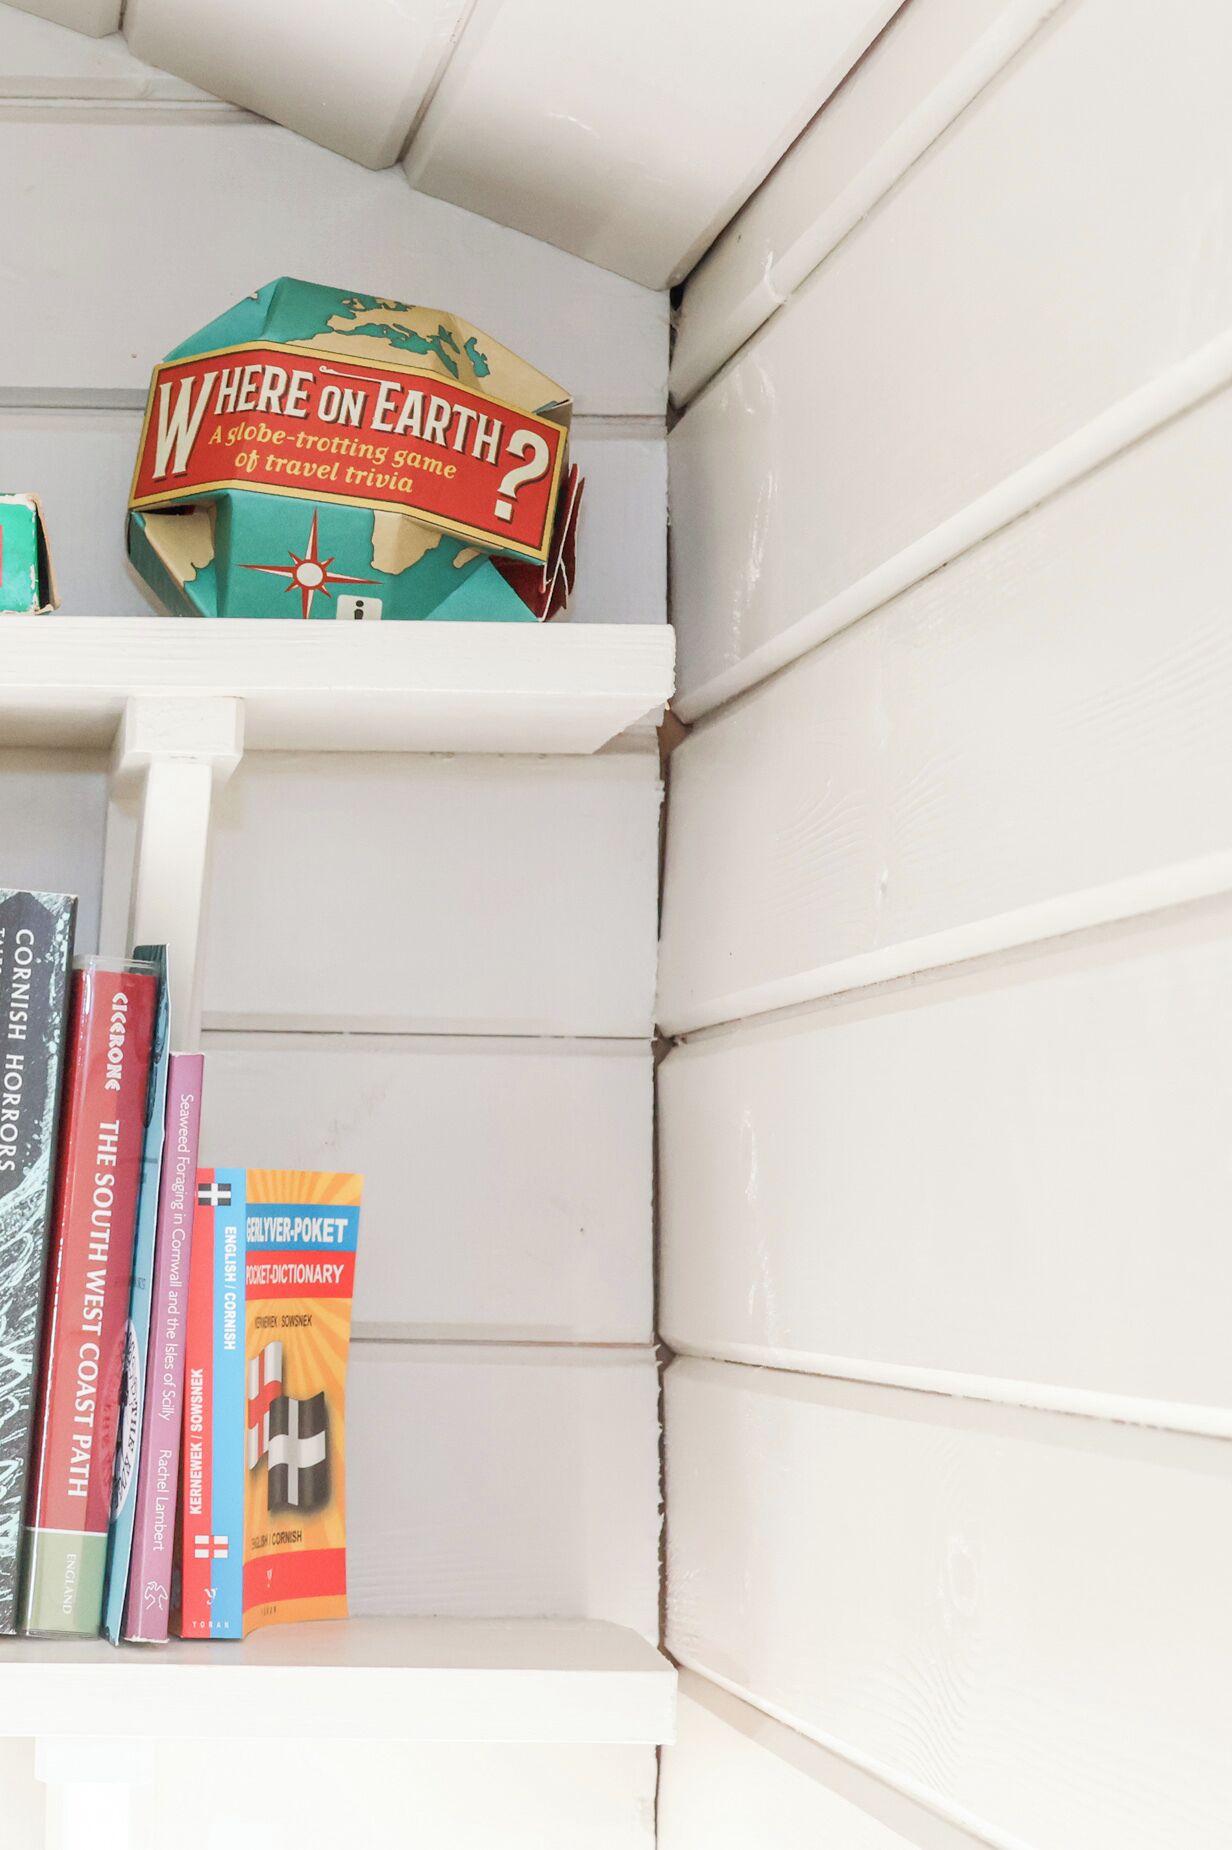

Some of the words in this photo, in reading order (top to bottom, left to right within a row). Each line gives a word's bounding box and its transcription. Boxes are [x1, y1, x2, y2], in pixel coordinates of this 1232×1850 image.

[152, 364, 314, 481] WHERE
[209, 425, 222, 446] A
[226, 422, 388, 464] globe-trotting
[394, 450, 458, 480] game
[235, 450, 259, 473] of
[265, 454, 339, 482] travel
[345, 466, 414, 494] trivia
[8, 928, 34, 1041] CORNISH
[97, 1119, 120, 1167] THE
[178, 1094, 194, 1153] Seaweed
[171, 1157, 190, 1210] Foraging
[88, 1173, 115, 1262] SOUTH
[173, 1213, 186, 1224] in
[247, 1216, 349, 1243] GERLYVER-POKET
[169, 1229, 186, 1287] Cornwall
[224, 1226, 237, 1282] ENGLISH
[246, 1264, 345, 1285] POCKET-DICTIONARY
[81, 1269, 108, 1336] WEST
[166, 1318, 179, 1340] the
[168, 1292, 181, 1315] and
[224, 1292, 236, 1350] CORNISH
[163, 1374, 176, 1388] of
[164, 1344, 178, 1370] Isles
[72, 1342, 100, 1432] COAST
[158, 1391, 176, 1421] Scilly
[190, 1368, 203, 1432] SOWSNEK
[68, 1436, 93, 1498] PATH
[158, 1450, 172, 1492] Rachel
[189, 1442, 203, 1514] KERNEWEK
[152, 1497, 169, 1551] Lambert
[63, 1554, 76, 1614] ENGLAND
